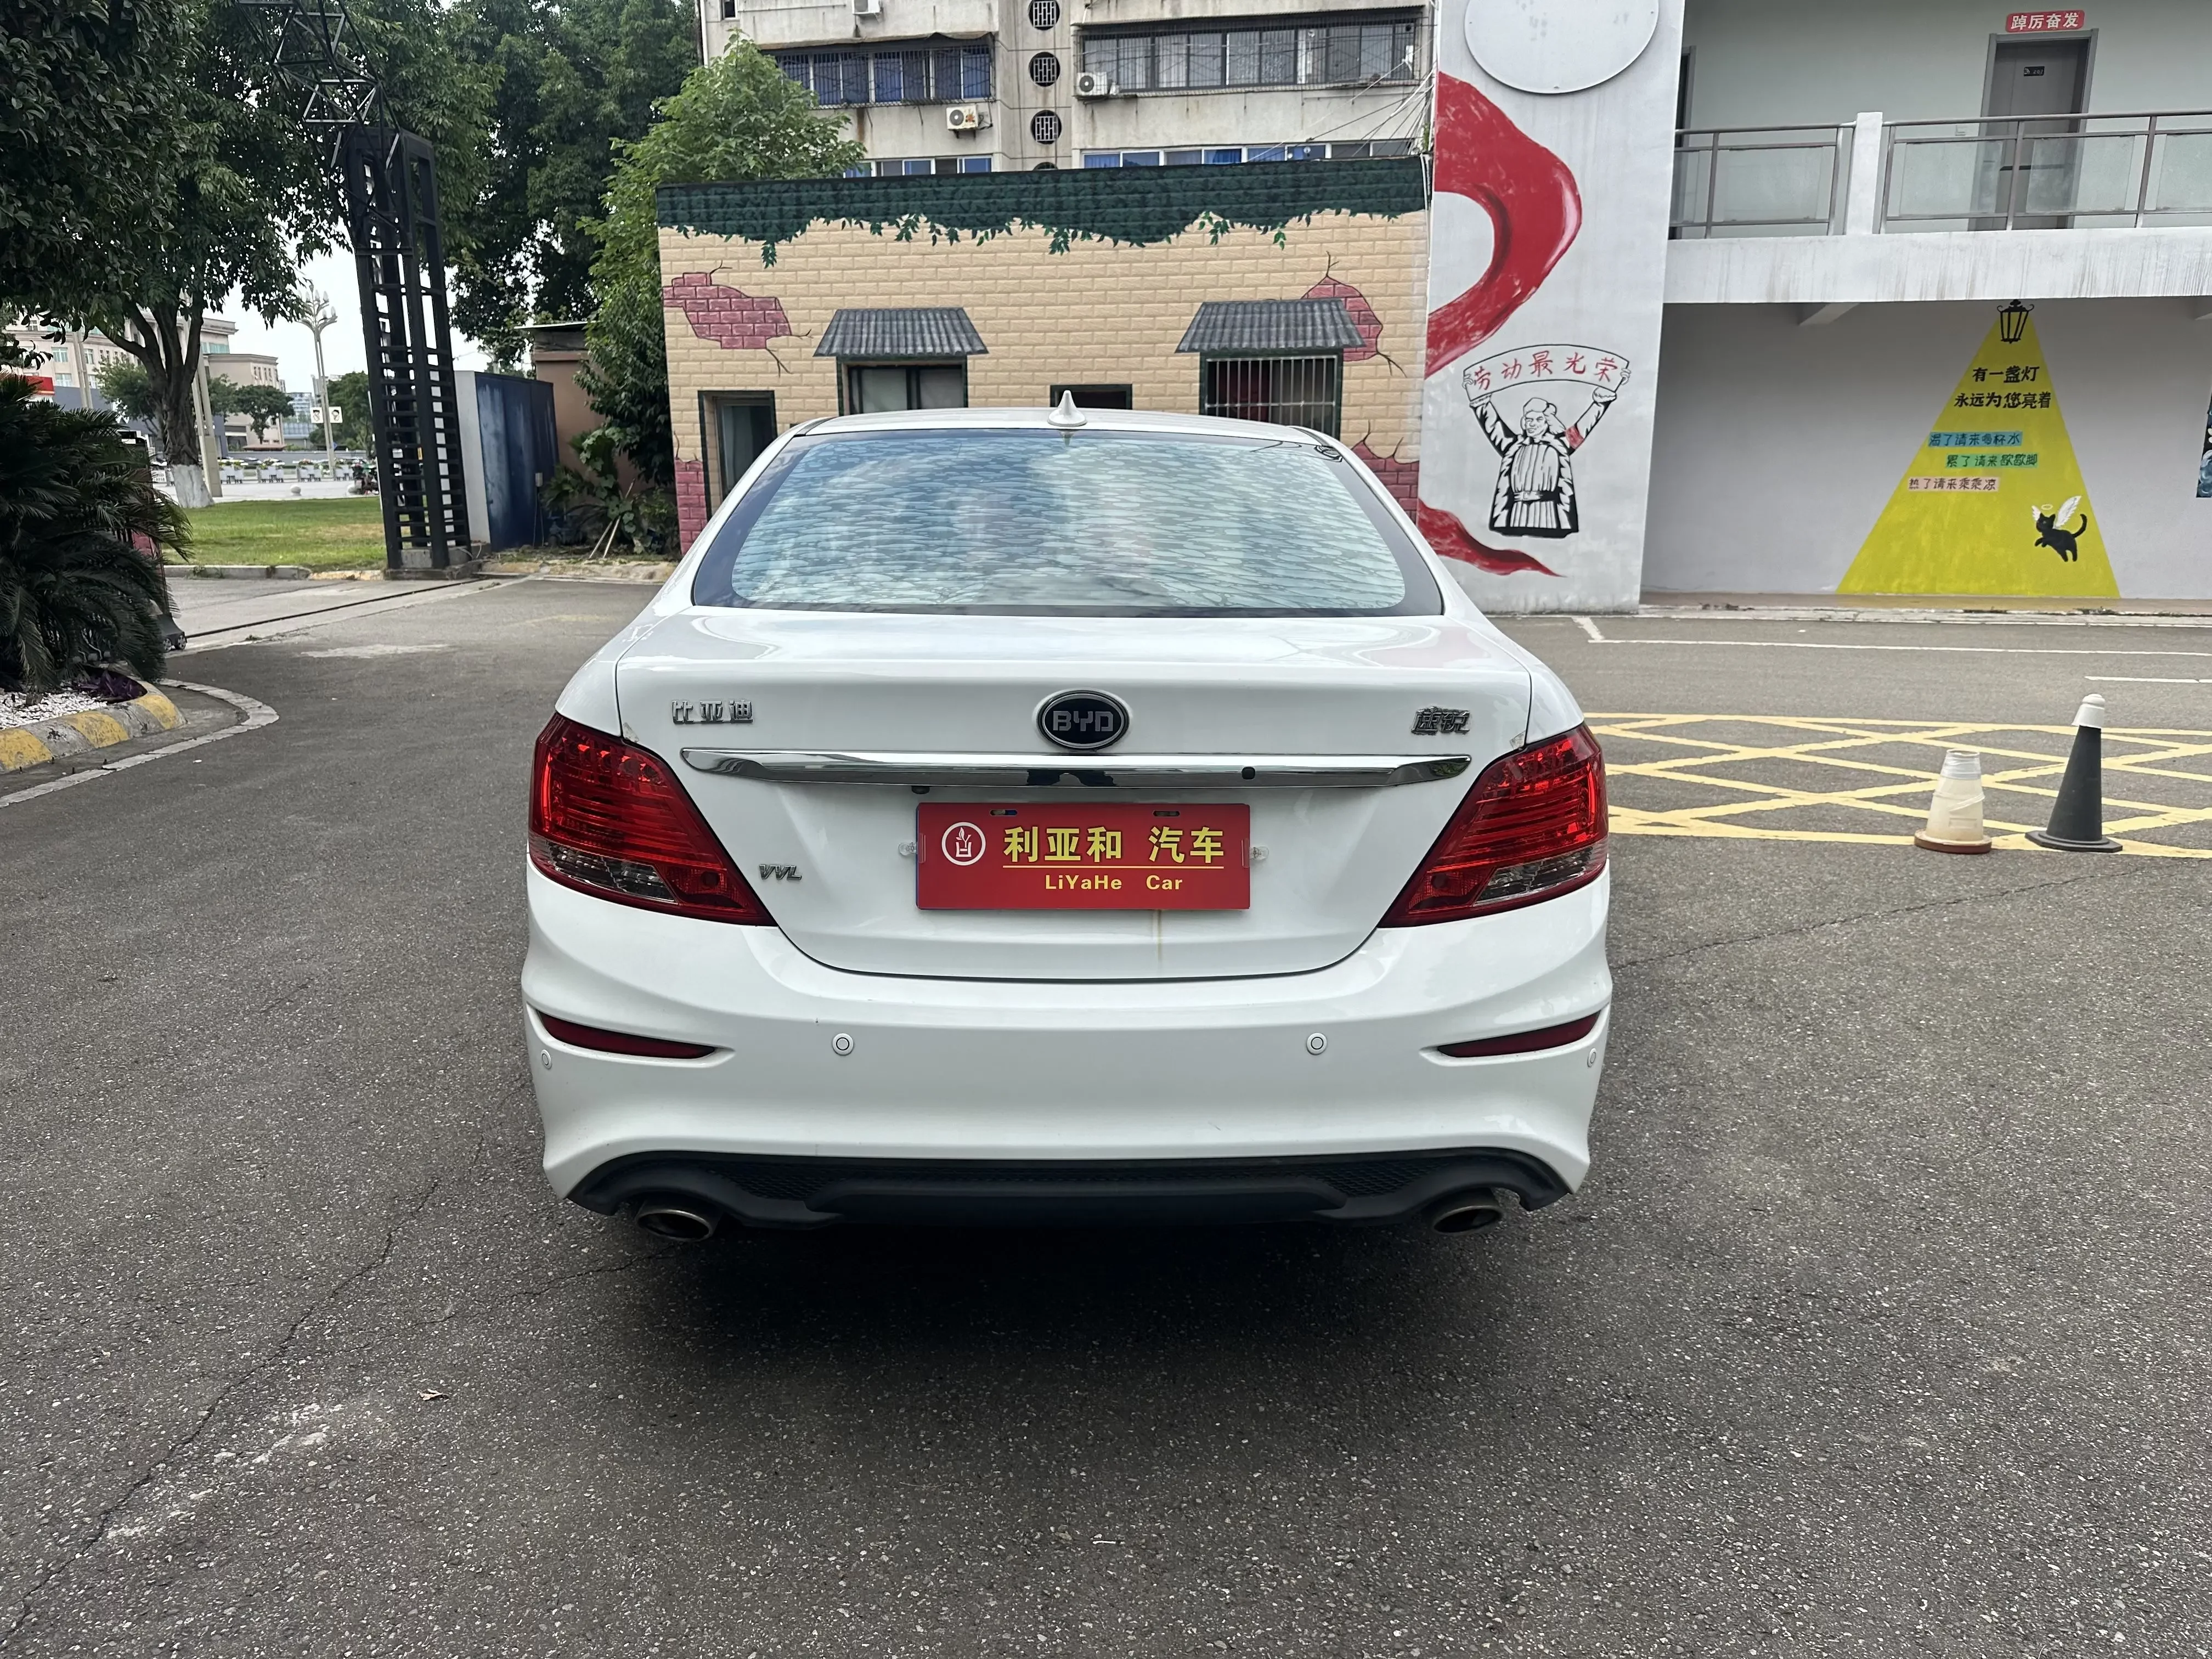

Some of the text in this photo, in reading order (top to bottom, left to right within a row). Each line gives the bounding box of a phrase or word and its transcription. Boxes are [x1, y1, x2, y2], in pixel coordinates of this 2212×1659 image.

[2011, 12, 2079, 30] 踔厉奋发
[1474, 351, 1618, 390] 劳动最光荣
[1972, 365, 2039, 383] 有一盏灯
[1954, 391, 2051, 409] 永远为您亮着
[1947, 454, 2038, 467] 累了请来歇歇脚
[1909, 477, 1996, 490] 热了请来乘乘凉
[672, 699, 753, 724] 比亚迪
[1053, 710, 1114, 732] BYD
[1411, 706, 1470, 736] 速锐
[1003, 826, 1224, 864] 利亚和 汽车
[759, 865, 802, 880] VVL
[1045, 874, 1183, 890] LiYaHe Car
